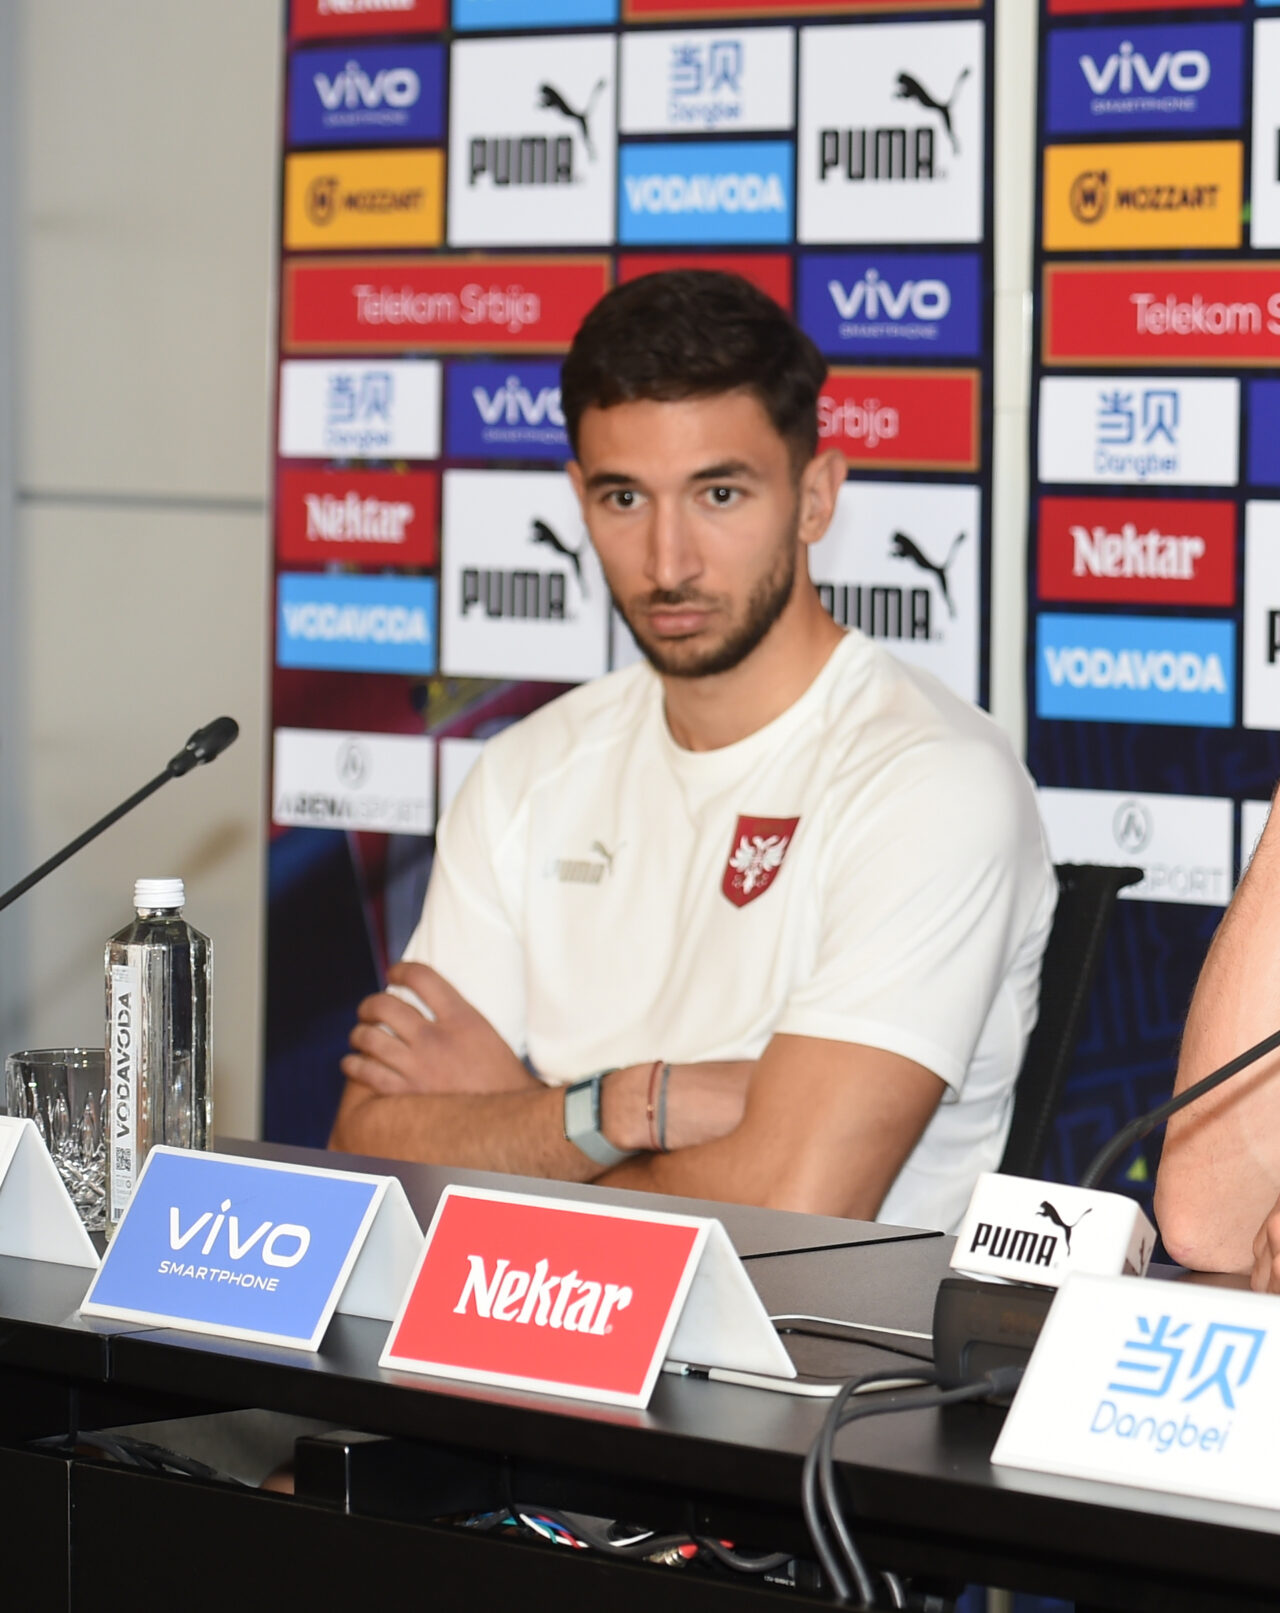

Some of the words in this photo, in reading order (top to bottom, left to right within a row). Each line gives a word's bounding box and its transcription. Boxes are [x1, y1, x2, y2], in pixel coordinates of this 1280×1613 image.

[313, 60, 421, 110] vivo
[1080, 40, 1211, 94] vivo
[469, 136, 573, 186] PUMA
[819, 128, 935, 181] PUMA
[1115, 184, 1219, 212] MOZZART
[353, 284, 459, 325] Telekom
[827, 268, 951, 320] vivo
[1130, 293, 1262, 336] Telekom
[1096, 388, 1179, 445] 当贝
[1094, 450, 1178, 481] Dangbei
[304, 491, 415, 544] Nektar
[1070, 523, 1205, 580] Nektar
[462, 567, 566, 620] PUMA
[1044, 647, 1227, 694] VODAVODA
[116, 992, 132, 1139] VODAVODA
[169, 1198, 311, 1268] vivo
[969, 1222, 1058, 1267] PUMA
[158, 1260, 280, 1292] SMARTPHONE
[453, 1254, 633, 1335] Nektar
[1107, 1315, 1267, 1410] 当贝
[1089, 1400, 1234, 1454] Dangbei
